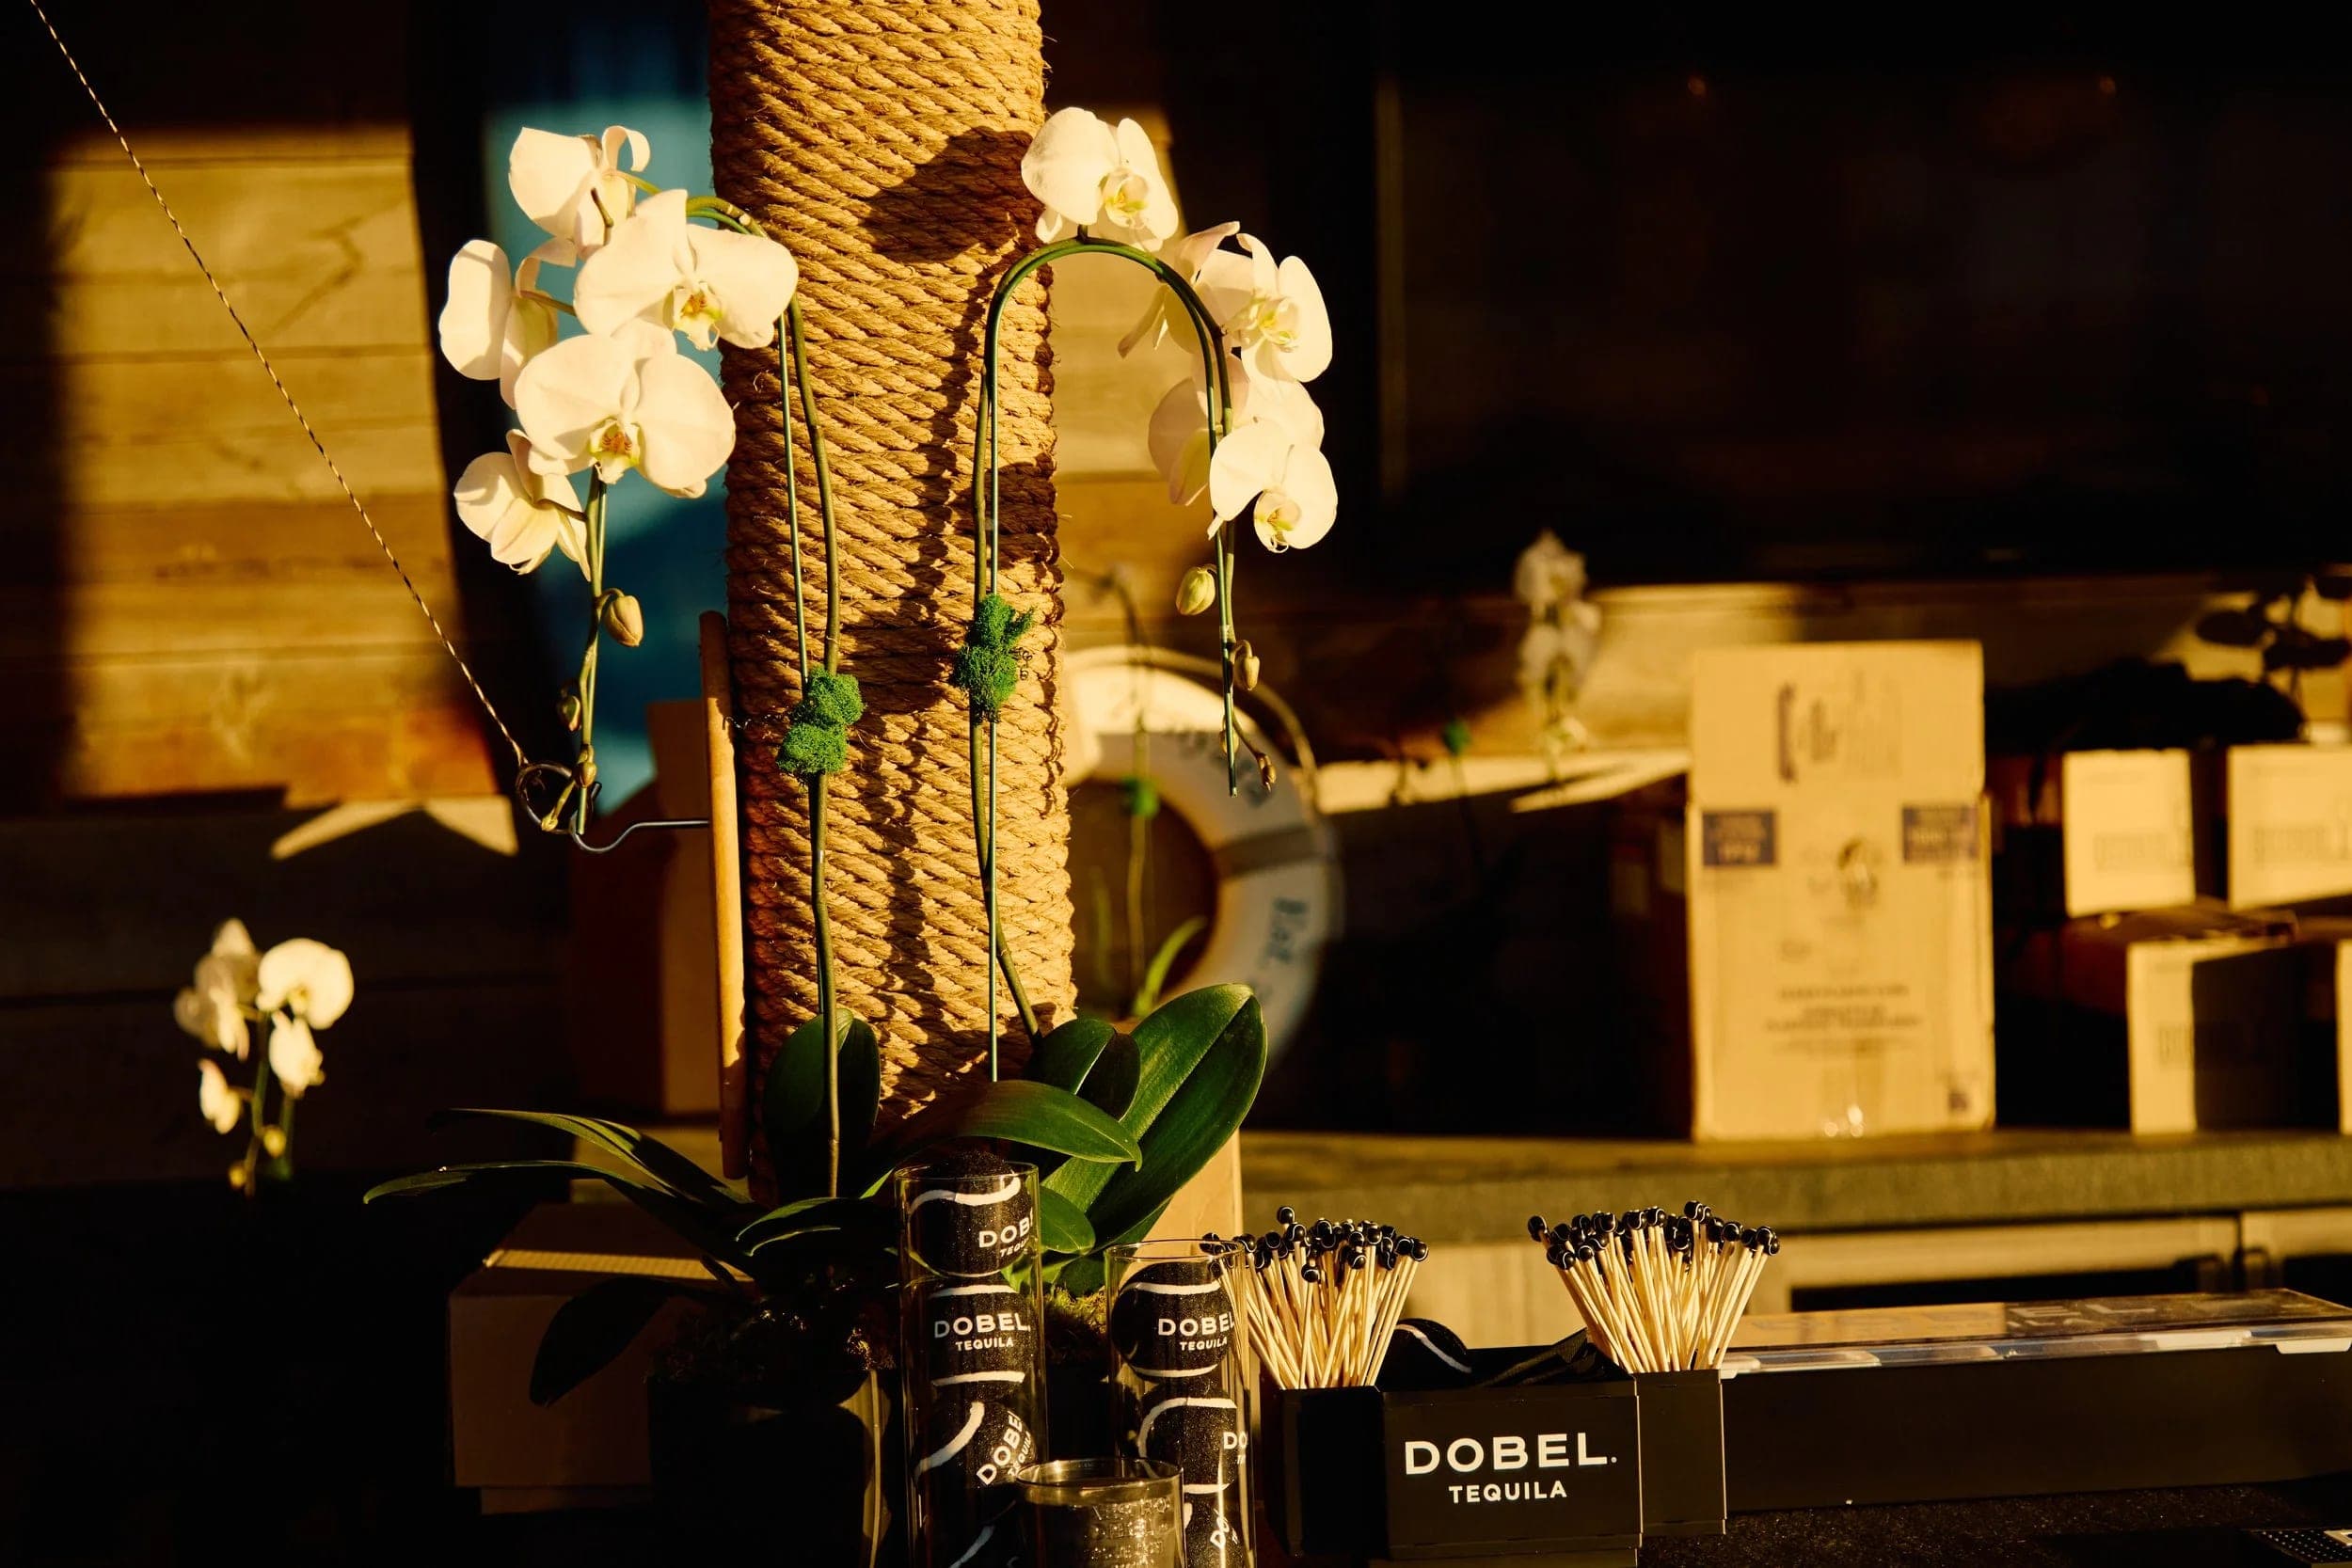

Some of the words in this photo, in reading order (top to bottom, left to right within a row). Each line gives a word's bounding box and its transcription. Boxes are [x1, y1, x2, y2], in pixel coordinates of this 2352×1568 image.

[978, 1207, 1033, 1248] DOB
[1000, 1235, 1029, 1258] TEQU
[955, 1337, 1014, 1352] TEQUILA
[977, 1410, 1023, 1485] DOBE
[1448, 1480, 1567, 1504] TEQUILA
